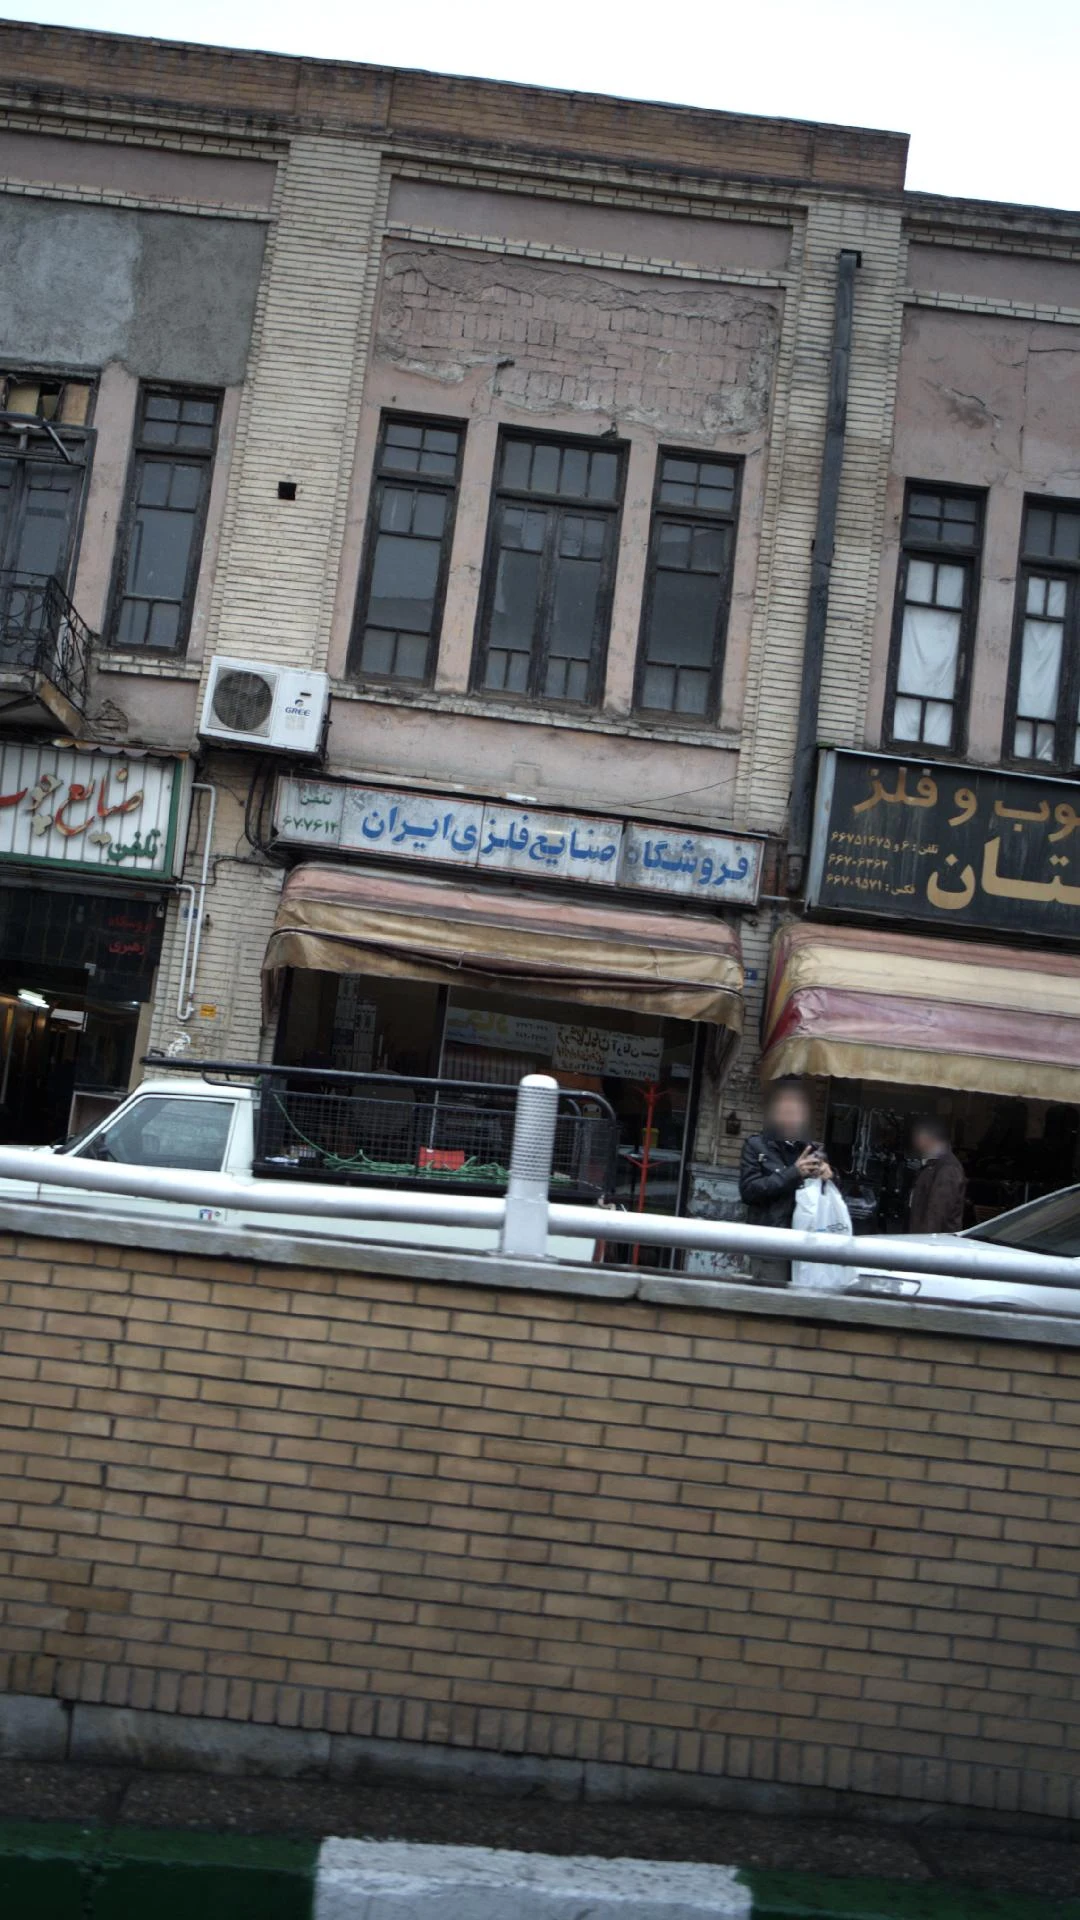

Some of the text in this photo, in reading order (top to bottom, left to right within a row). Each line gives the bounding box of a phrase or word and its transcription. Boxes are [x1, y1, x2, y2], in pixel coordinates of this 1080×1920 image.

[285, 706, 311, 717] GREE
[300, 791, 333, 805] تلفن
[852, 766, 1080, 843] وب و فلز
[107, 829, 161, 862] تلفن
[361, 805, 453, 849] ایران
[451, 815, 529, 854] فلزی
[528, 827, 617, 866] صنایع
[926, 836, 1080, 910] تان
